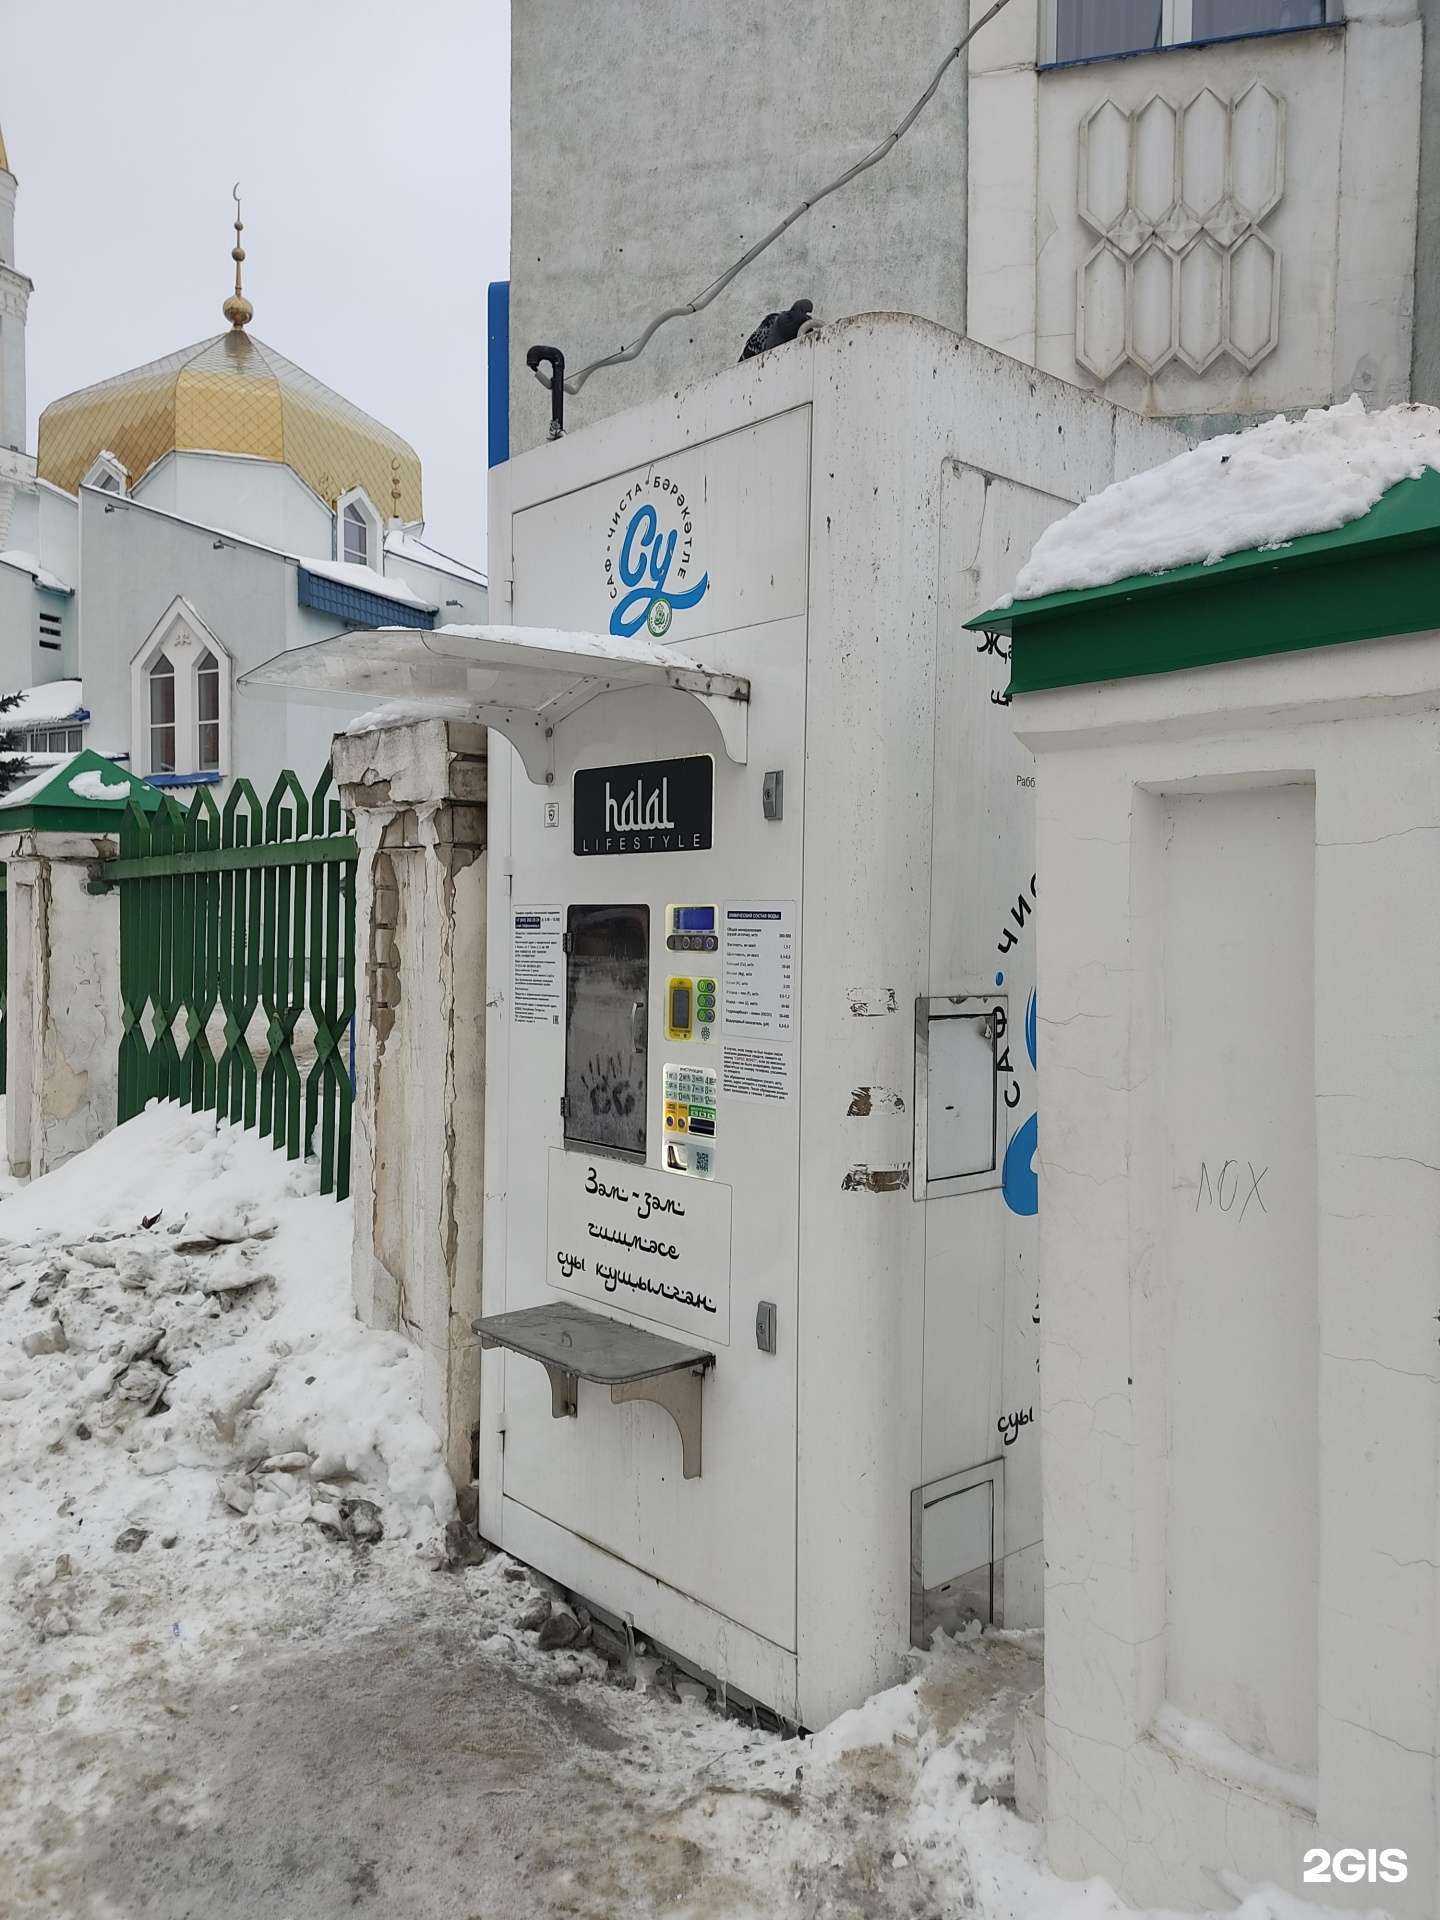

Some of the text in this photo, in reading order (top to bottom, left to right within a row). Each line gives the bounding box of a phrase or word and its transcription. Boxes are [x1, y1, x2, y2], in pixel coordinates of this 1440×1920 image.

[607, 482, 643, 539] ЧИСТА
[653, 475, 693, 580] БӘРӘКӘТЛЕ
[605, 776, 675, 833] halal
[582, 833, 702, 853] LIFESTYLE
